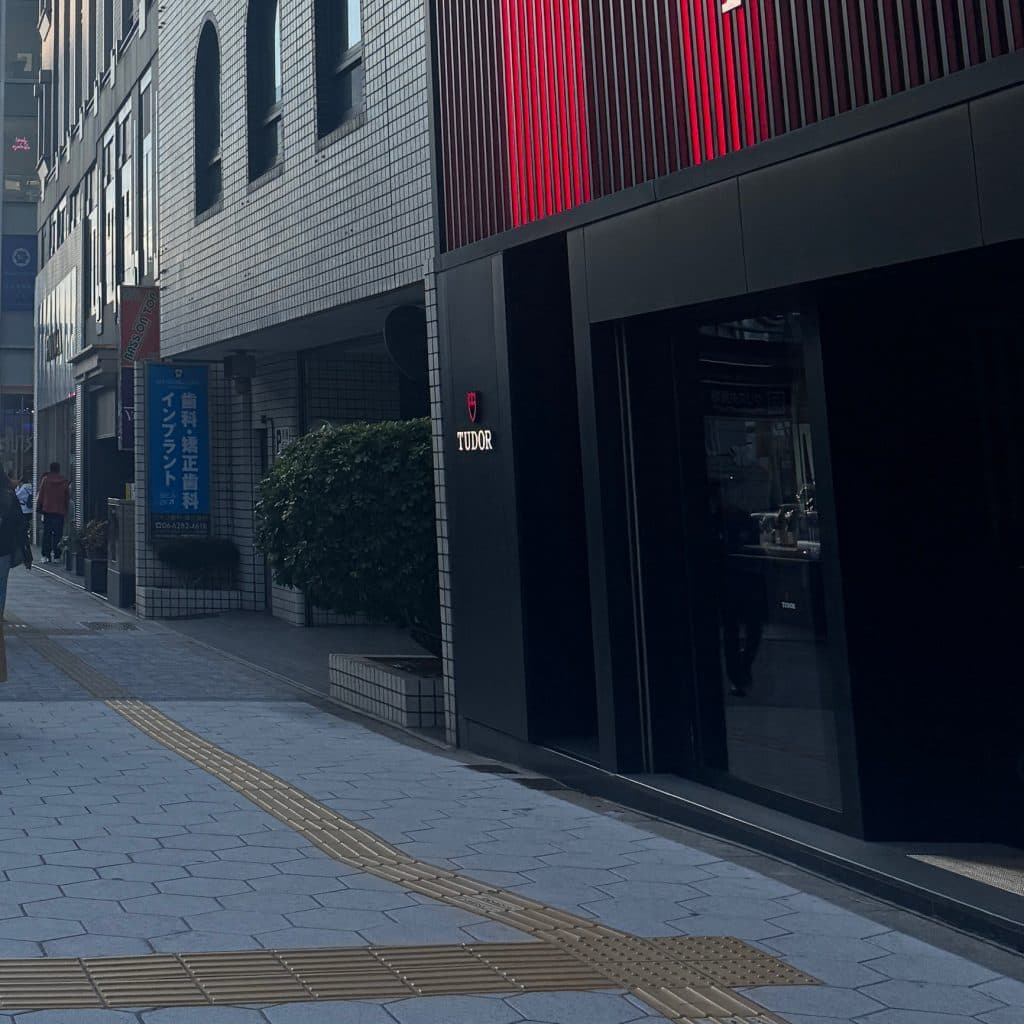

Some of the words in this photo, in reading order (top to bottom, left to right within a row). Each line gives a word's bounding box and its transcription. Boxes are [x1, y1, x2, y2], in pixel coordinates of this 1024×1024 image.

[161, 392, 177, 487] インプラント
[181, 392, 199, 510] 歯科・矯正歯科
[457, 430, 493, 451] TUDOR
